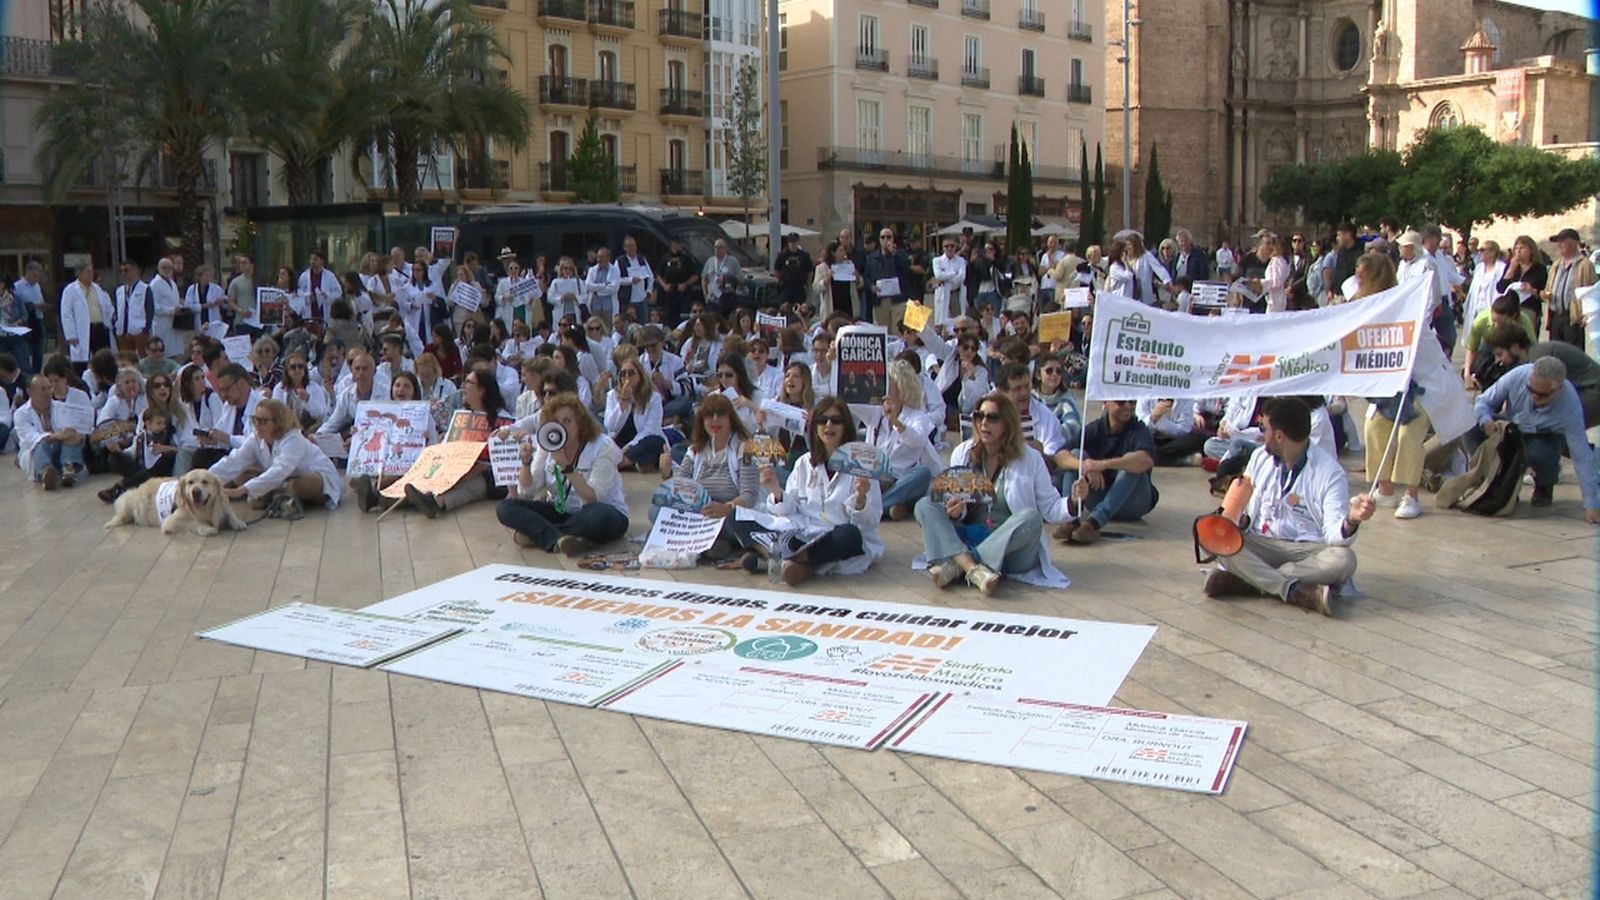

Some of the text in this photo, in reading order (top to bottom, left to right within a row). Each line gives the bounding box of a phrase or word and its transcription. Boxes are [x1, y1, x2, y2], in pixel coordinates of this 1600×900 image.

[841, 333, 882, 349] MÓNICA
[1116, 333, 1184, 358] Estatuto
[1356, 326, 1404, 348] OFERTA
[1114, 354, 1135, 367] del
[1279, 359, 1330, 379] Médico
[1355, 350, 1404, 369] MÉDICO
[1113, 371, 1121, 383] y
[1126, 370, 1191, 389] Facultativo
[494, 573, 664, 598] Condiciones
[774, 602, 853, 618] para
[856, 610, 967, 629] cuidar
[970, 621, 1079, 640] mejor
[498, 591, 705, 622] ¡SALVEMOS
[701, 611, 756, 629] LA
[755, 617, 965, 651] SANIDAD!
[942, 659, 1013, 675] Sindicato
